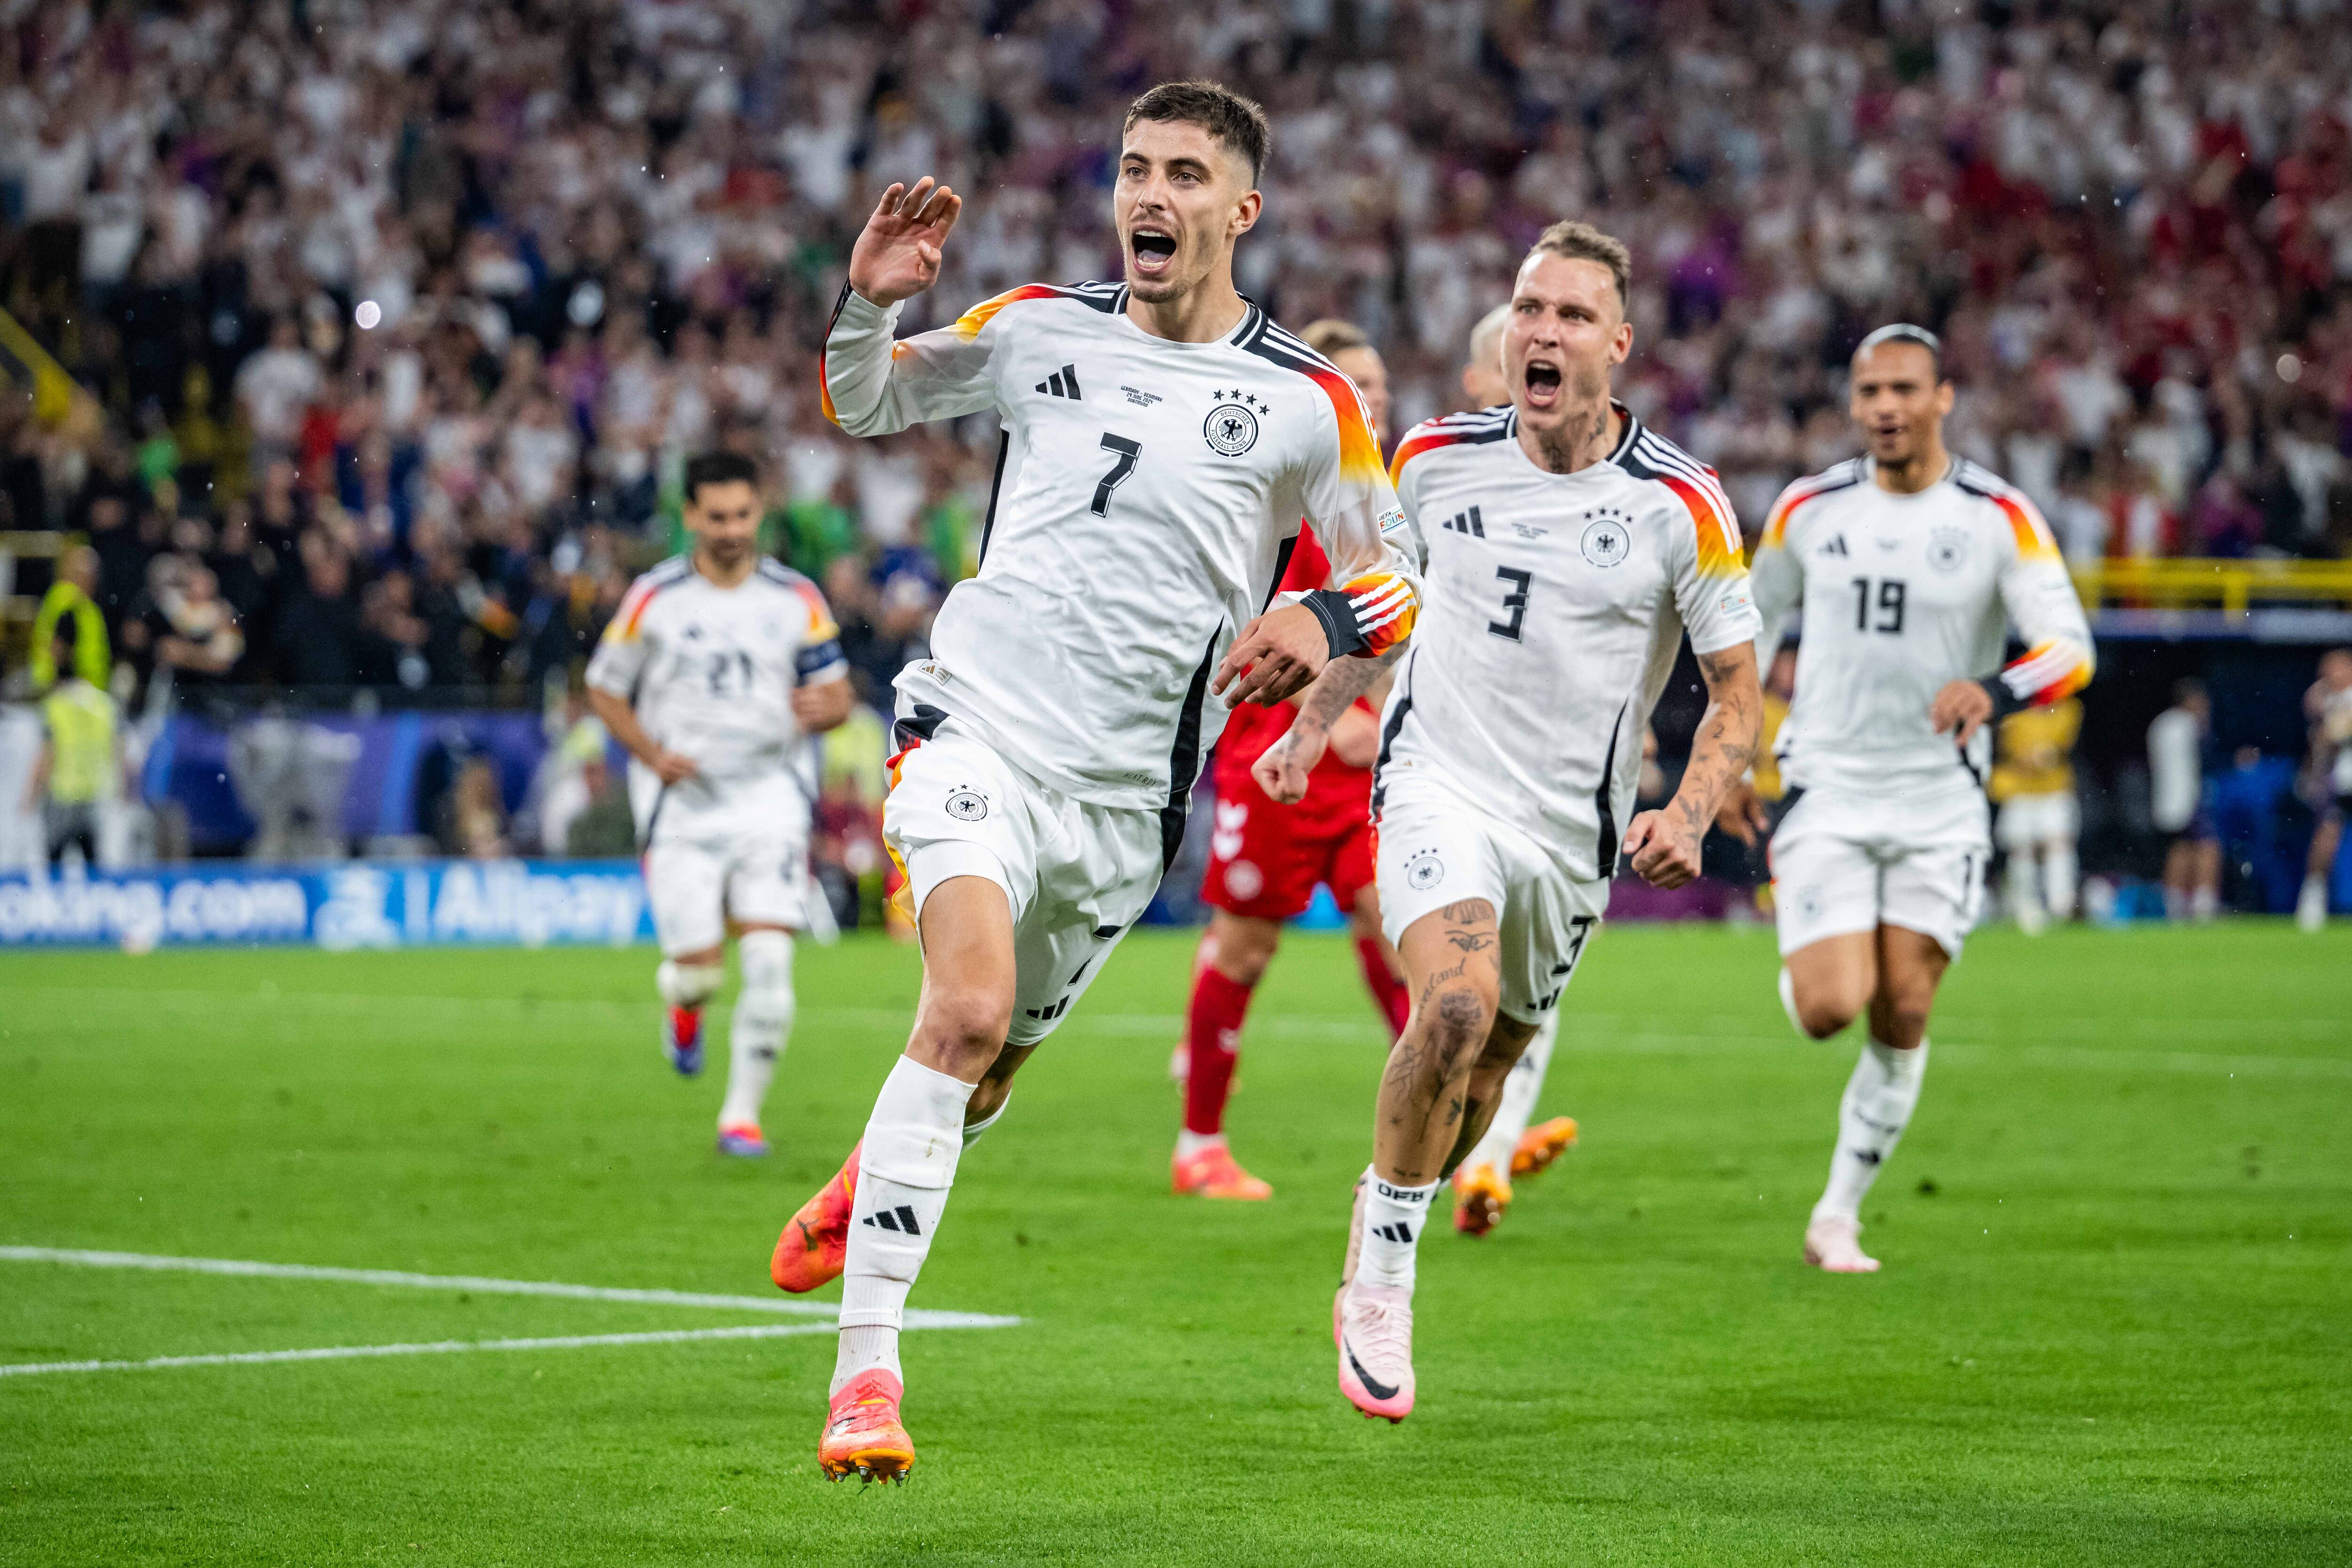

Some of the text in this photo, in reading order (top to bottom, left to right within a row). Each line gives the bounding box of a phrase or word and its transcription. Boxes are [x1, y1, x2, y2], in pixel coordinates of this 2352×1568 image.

[1120, 385, 1140, 395] GERMANY
[1144, 392, 1163, 402] DENMARK
[1127, 397, 1148, 407] DORTMUND
[1220, 411, 1250, 425] DEUTSCHER
[1211, 429, 1247, 450] FUSSBALL-BUND
[1090, 431, 1143, 518] 7
[1379, 511, 1391, 521] UEFA
[1380, 511, 1405, 530] FOUN
[1487, 564, 1534, 643] 3
[1851, 575, 1906, 635] 19
[1122, 772, 1158, 786] HEAT.RDY
[1378, 1183, 1424, 1202] DFB
